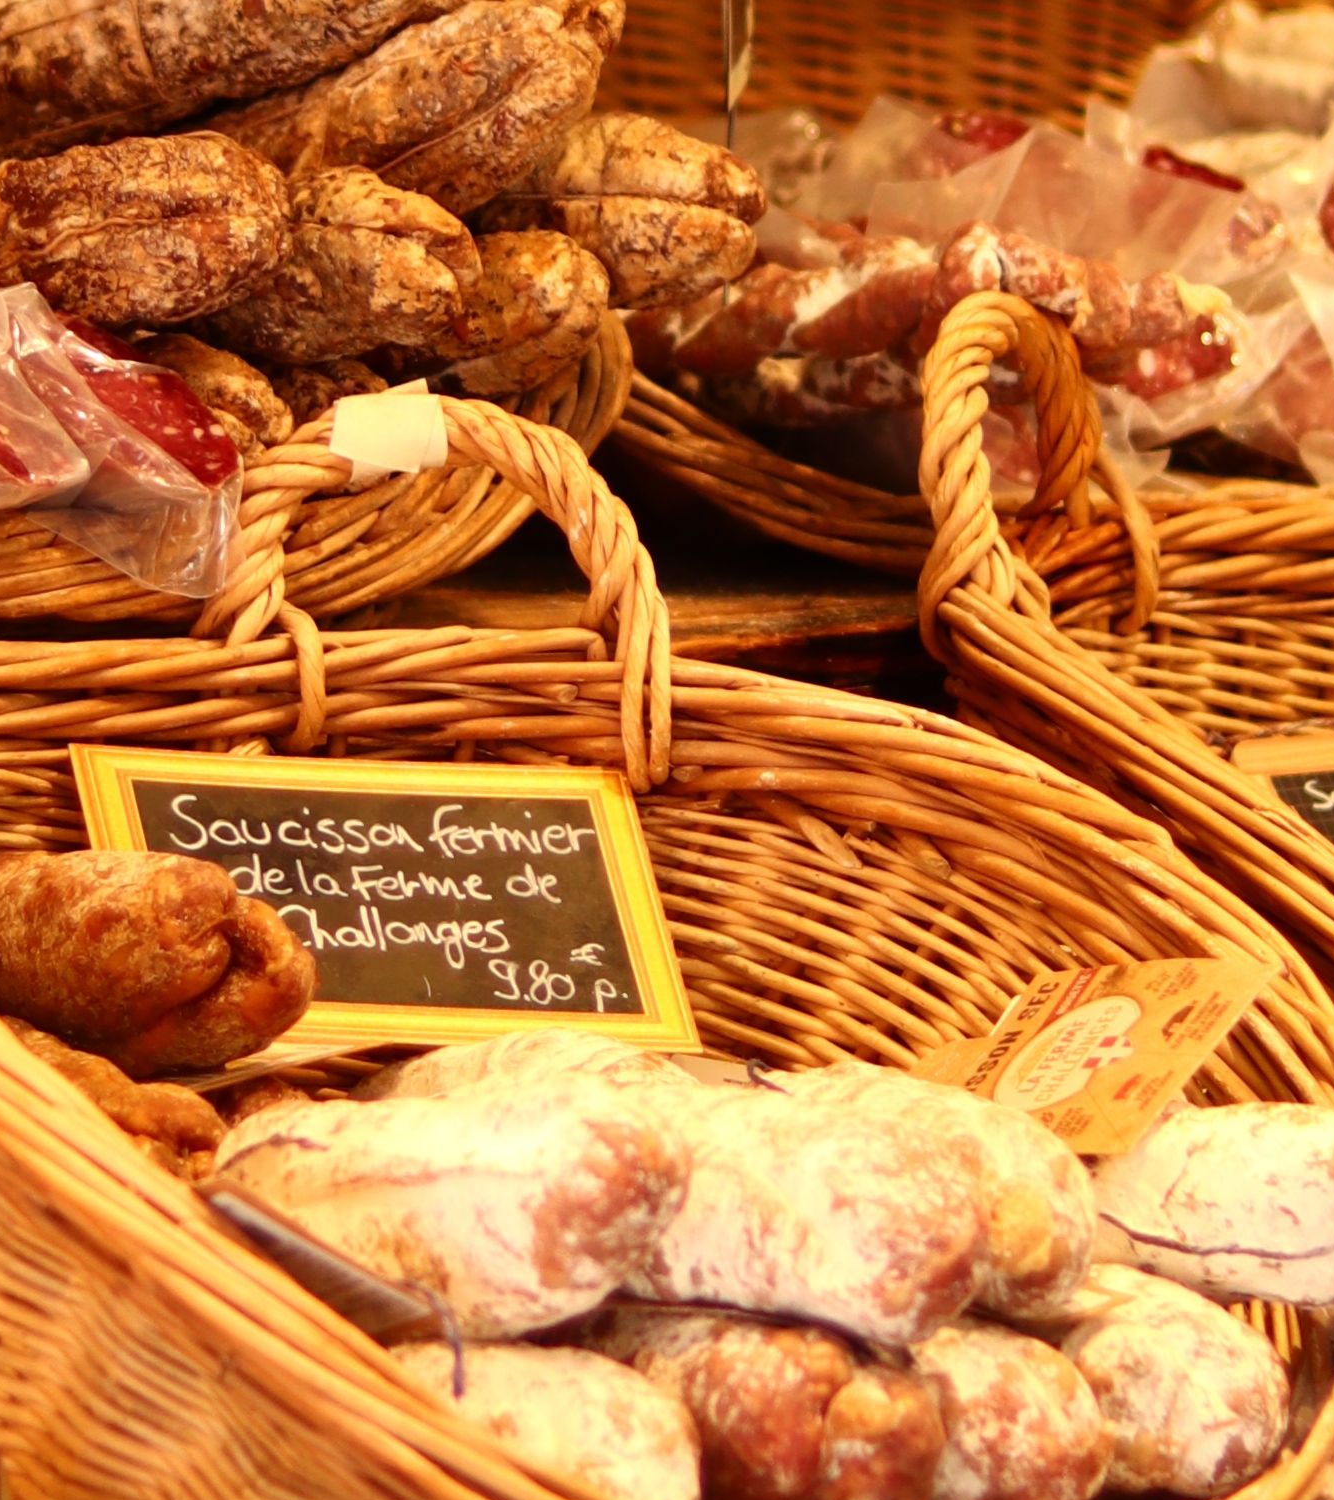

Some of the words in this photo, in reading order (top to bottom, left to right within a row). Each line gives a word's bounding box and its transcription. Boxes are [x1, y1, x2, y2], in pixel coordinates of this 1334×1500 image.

[169, 793, 424, 853] Saucisson
[227, 852, 295, 898] de
[296, 861, 344, 899] la
[350, 863, 496, 903] Ferme
[504, 863, 565, 904] de
